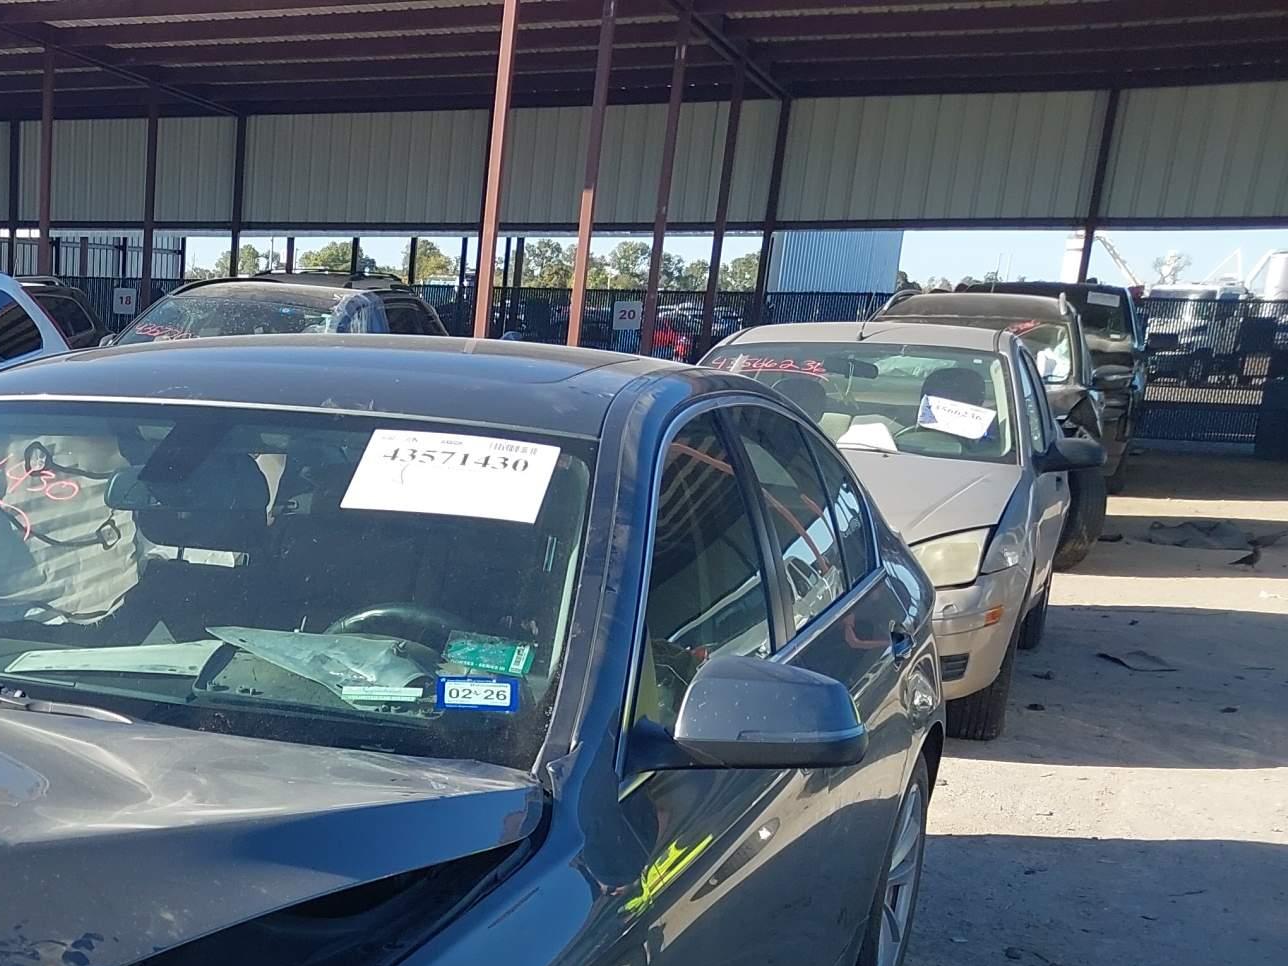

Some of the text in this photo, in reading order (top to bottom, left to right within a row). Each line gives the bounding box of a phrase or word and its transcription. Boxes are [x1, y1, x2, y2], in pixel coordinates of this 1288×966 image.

[119, 295, 132, 306] 18
[618, 309, 637, 320] 20
[383, 447, 530, 472] 43571430
[448, 688, 508, 702] 02 26
